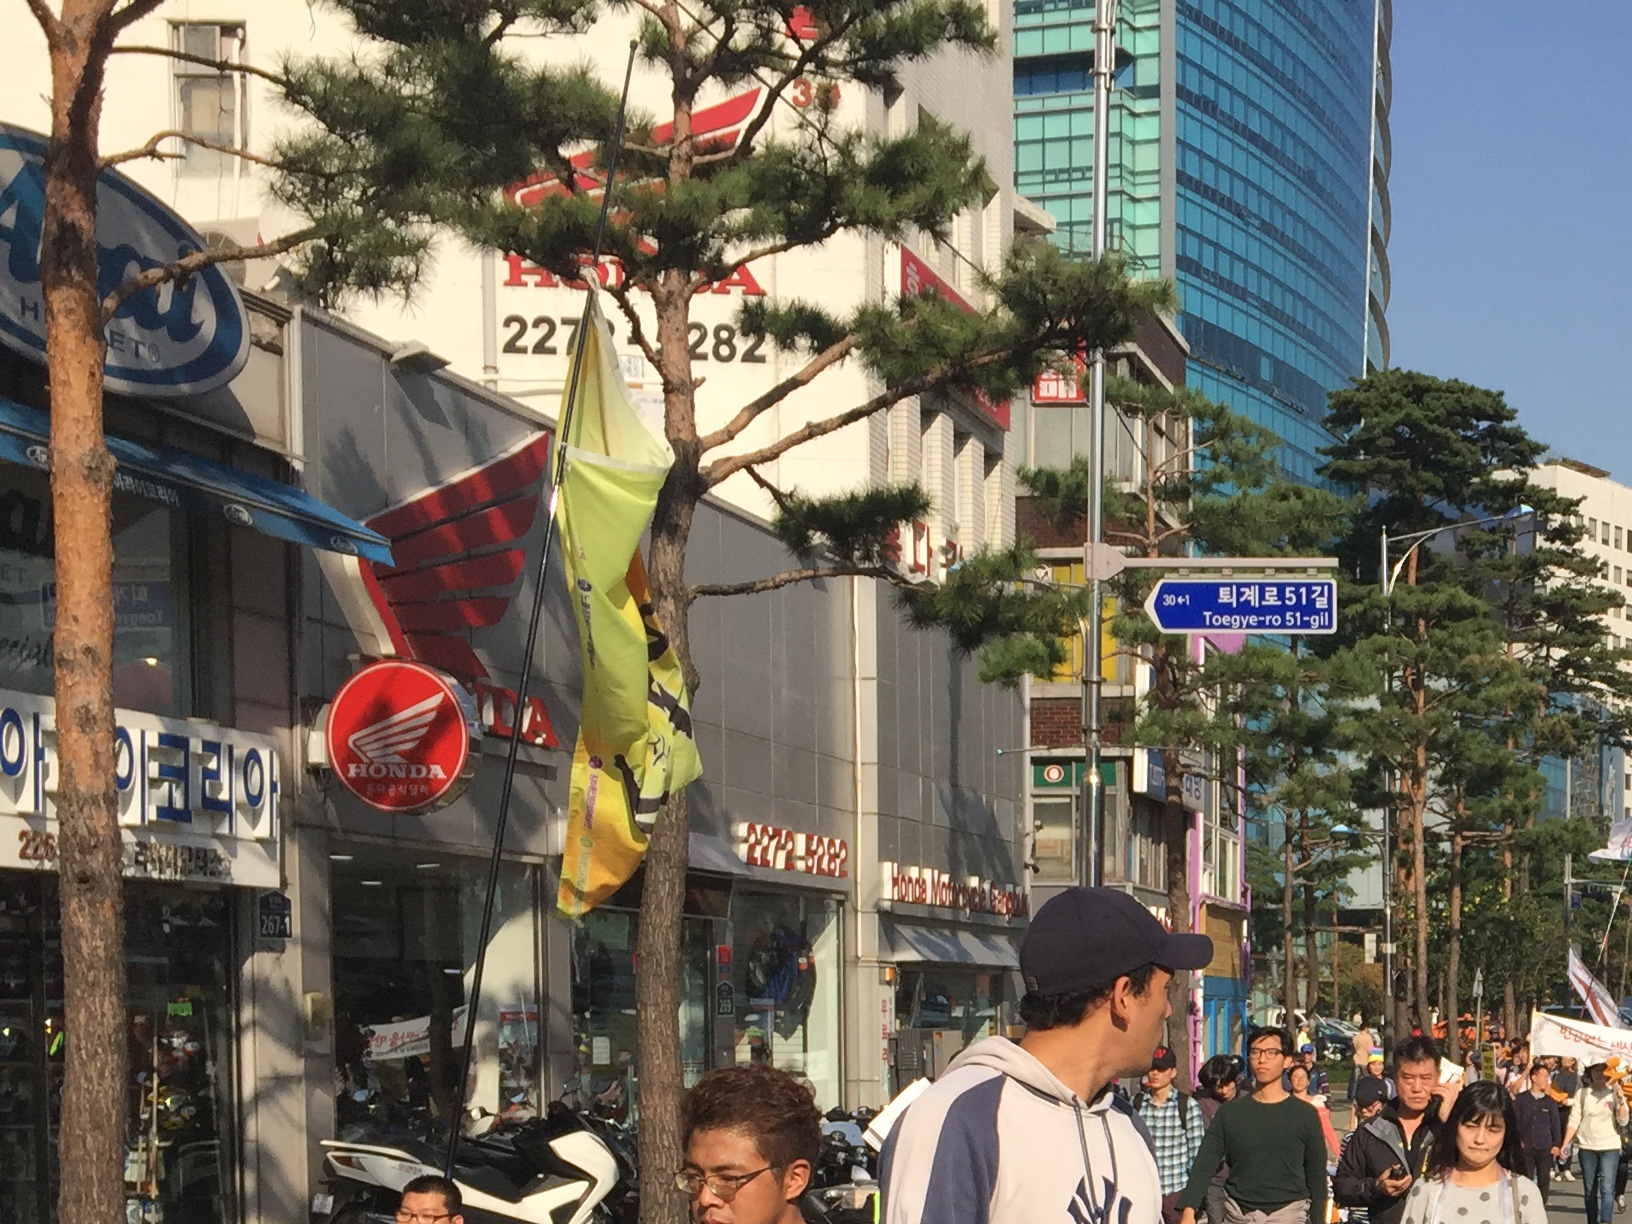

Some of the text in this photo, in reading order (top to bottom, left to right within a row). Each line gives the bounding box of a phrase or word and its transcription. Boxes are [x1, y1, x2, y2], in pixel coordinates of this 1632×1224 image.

[1203, 611, 1329, 629] Toegye-ro 51-gil
[0, 707, 280, 840] 아이코리아
[348, 763, 447, 779] HONDA
[892, 862, 927, 905] Honda
[261, 914, 291, 936] 267-1
